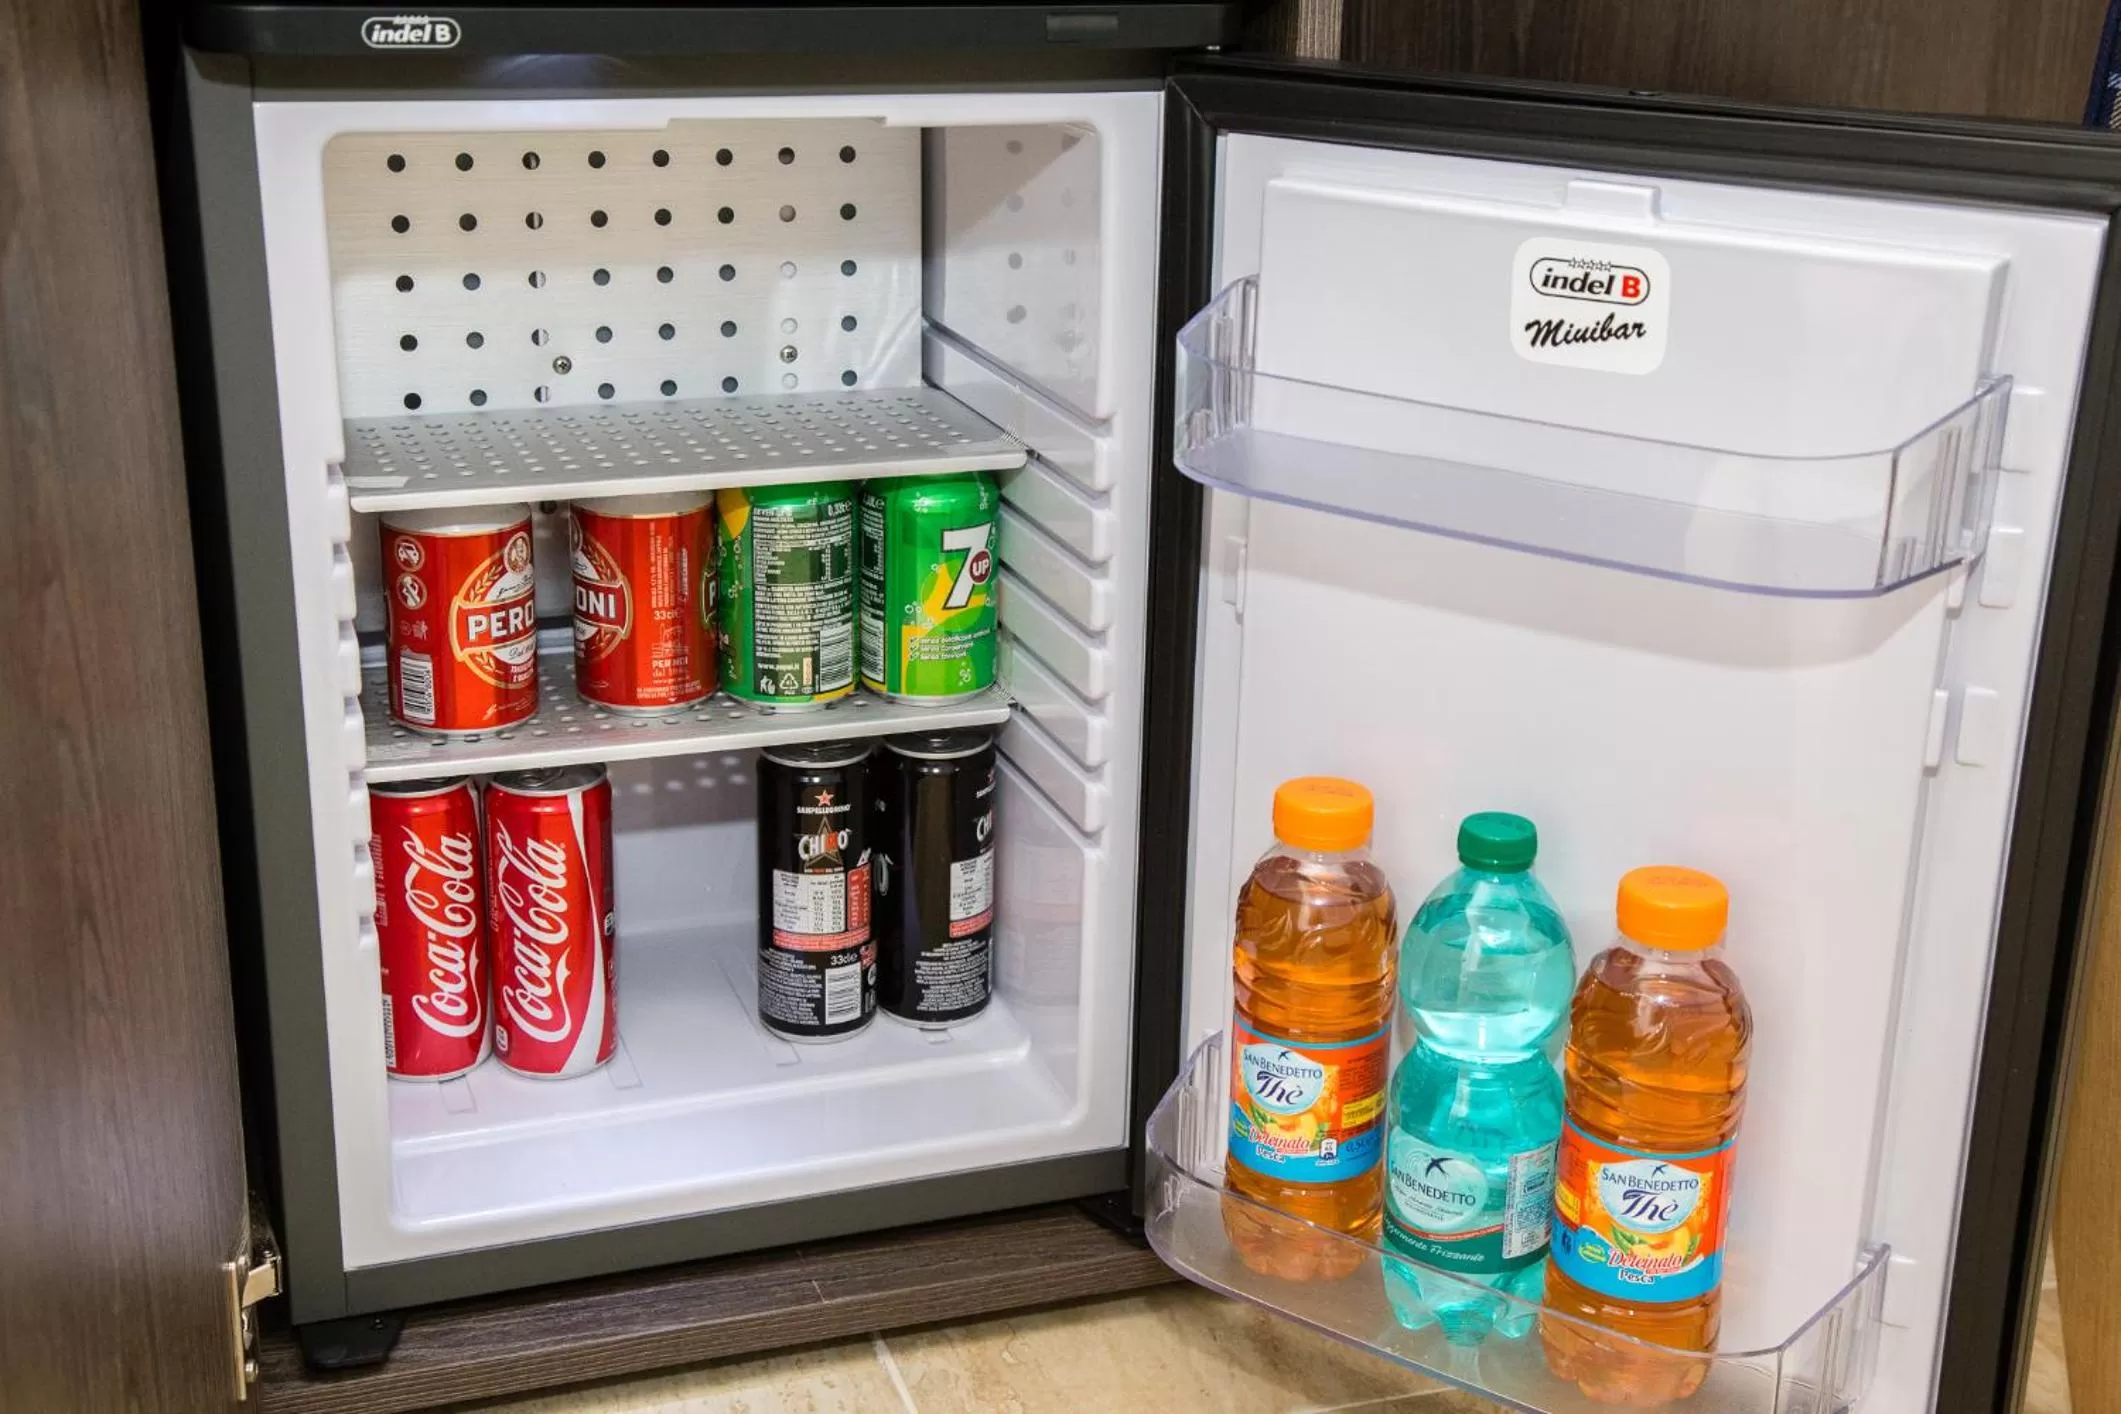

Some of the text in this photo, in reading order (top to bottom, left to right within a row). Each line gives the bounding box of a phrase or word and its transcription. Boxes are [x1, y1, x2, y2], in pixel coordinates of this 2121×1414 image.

[371, 24, 451, 43] indel B
[1541, 267, 1642, 299] indel B
[1524, 312, 1647, 348] Minibar
[942, 521, 992, 611] 7
[971, 559, 990, 578] UP
[575, 586, 618, 620] ONI
[467, 599, 535, 642] PERO
[1256, 1070, 1304, 1106] Thè
[1621, 1188, 1679, 1222] Thè
[1619, 1268, 1655, 1284] Pesca
